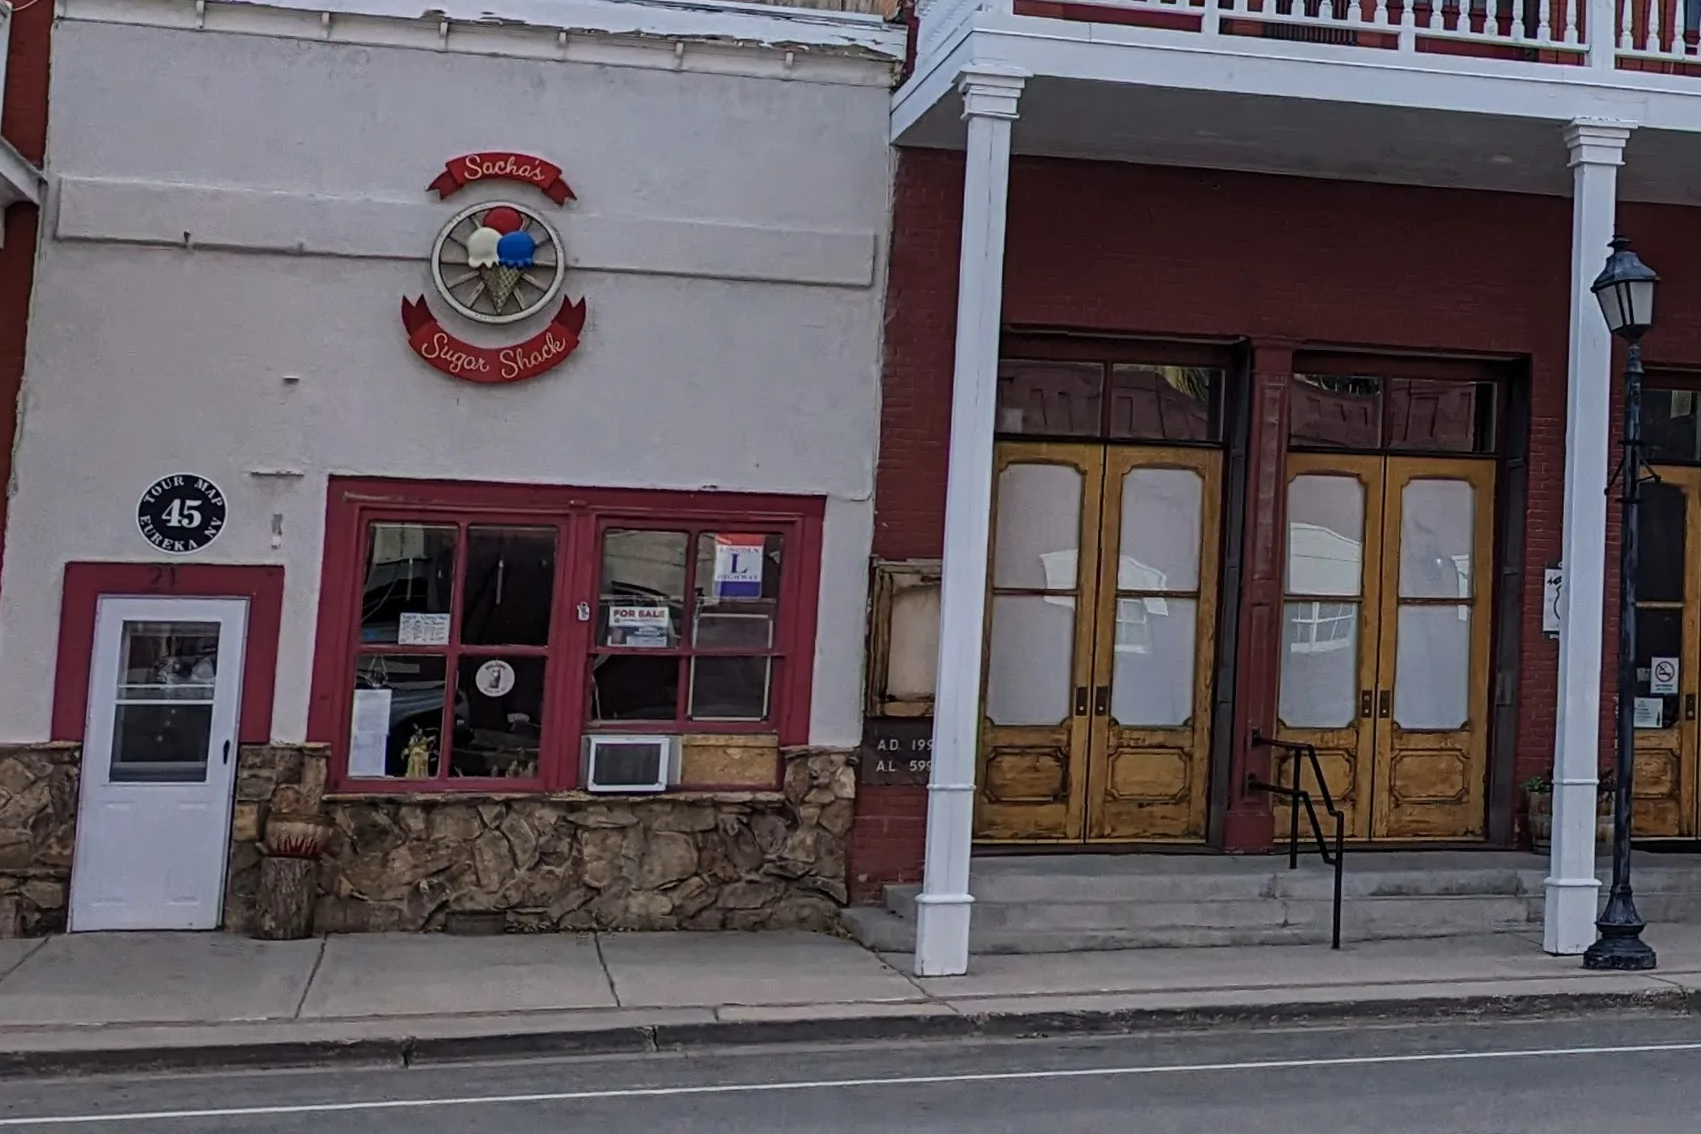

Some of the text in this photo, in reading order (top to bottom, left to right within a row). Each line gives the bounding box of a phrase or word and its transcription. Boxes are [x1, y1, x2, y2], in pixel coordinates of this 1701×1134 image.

[463, 154, 546, 181] Sacha's
[421, 332, 566, 379] Sugar Shack
[143, 476, 223, 506] TOUR MAP
[161, 498, 203, 529] 45
[140, 514, 223, 551] EUREKA NV
[730, 553, 749, 574] L
[613, 609, 635, 618] FOR
